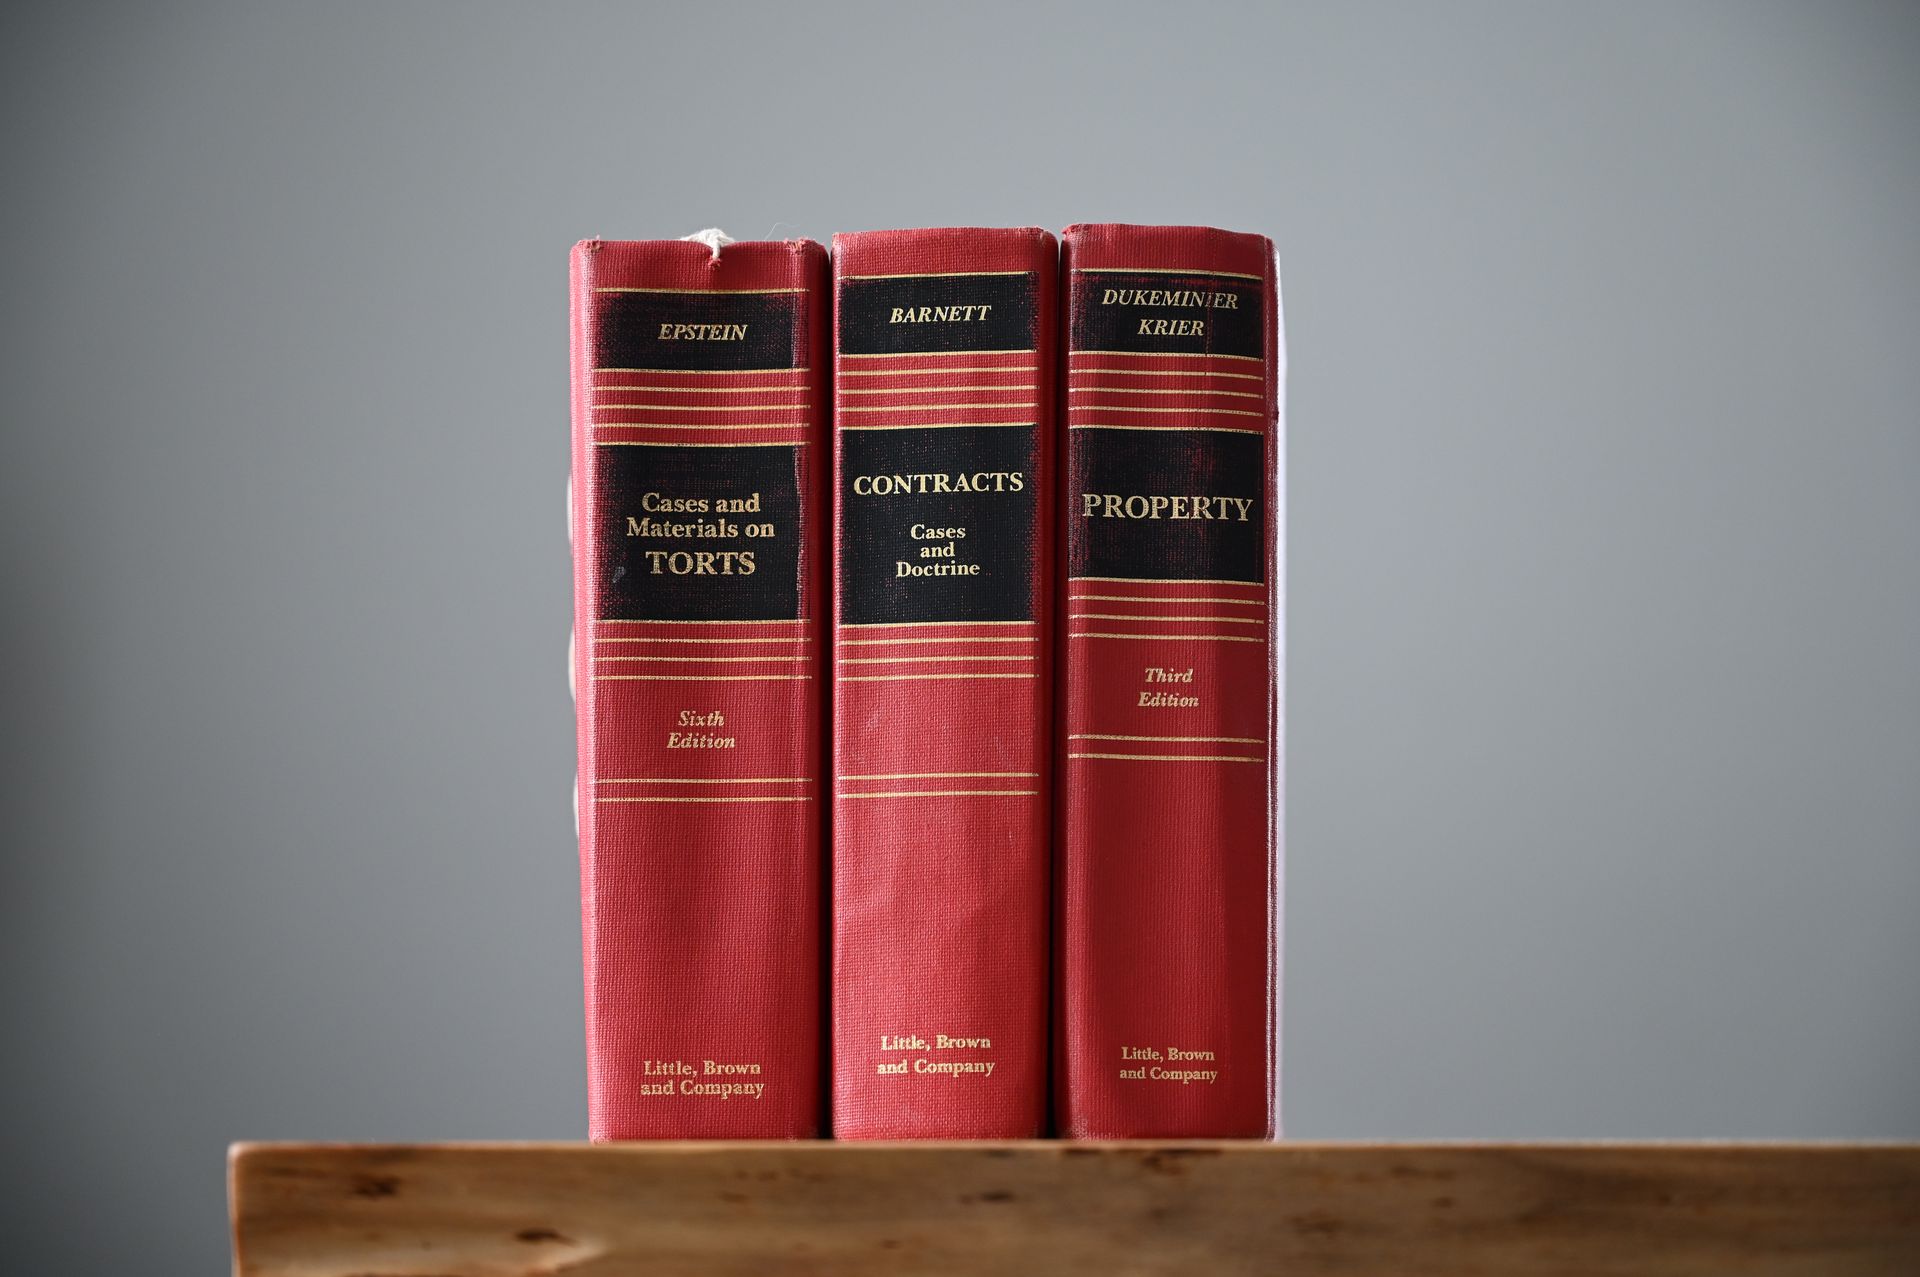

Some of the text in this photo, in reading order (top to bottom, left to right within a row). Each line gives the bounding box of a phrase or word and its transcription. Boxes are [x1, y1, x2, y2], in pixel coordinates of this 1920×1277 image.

[1102, 289, 1238, 310] DUKEMINIER
[889, 305, 992, 323] BARNETT
[658, 323, 748, 341] EPSTEIN
[1138, 319, 1204, 336] KRIER
[853, 472, 1024, 496] CONTRACTS
[642, 492, 760, 513] Cases and
[1082, 494, 1253, 521] PROPERTY
[626, 517, 775, 538] Materials on
[910, 523, 966, 540] Cases
[920, 541, 955, 558] and
[645, 550, 756, 576] TORTS
[896, 561, 980, 578] Doctrine
[1145, 667, 1193, 683] Third
[1138, 692, 1199, 708] Edition
[678, 710, 725, 727] Sixth
[667, 732, 735, 749] Edition
[881, 1034, 991, 1052] Little, Brown
[1121, 1046, 1215, 1062] Little, Brown
[643, 1060, 761, 1078] Little, Brown
[877, 1059, 995, 1078] and Company
[1119, 1066, 1218, 1084] and Company
[640, 1080, 764, 1100] and Company
